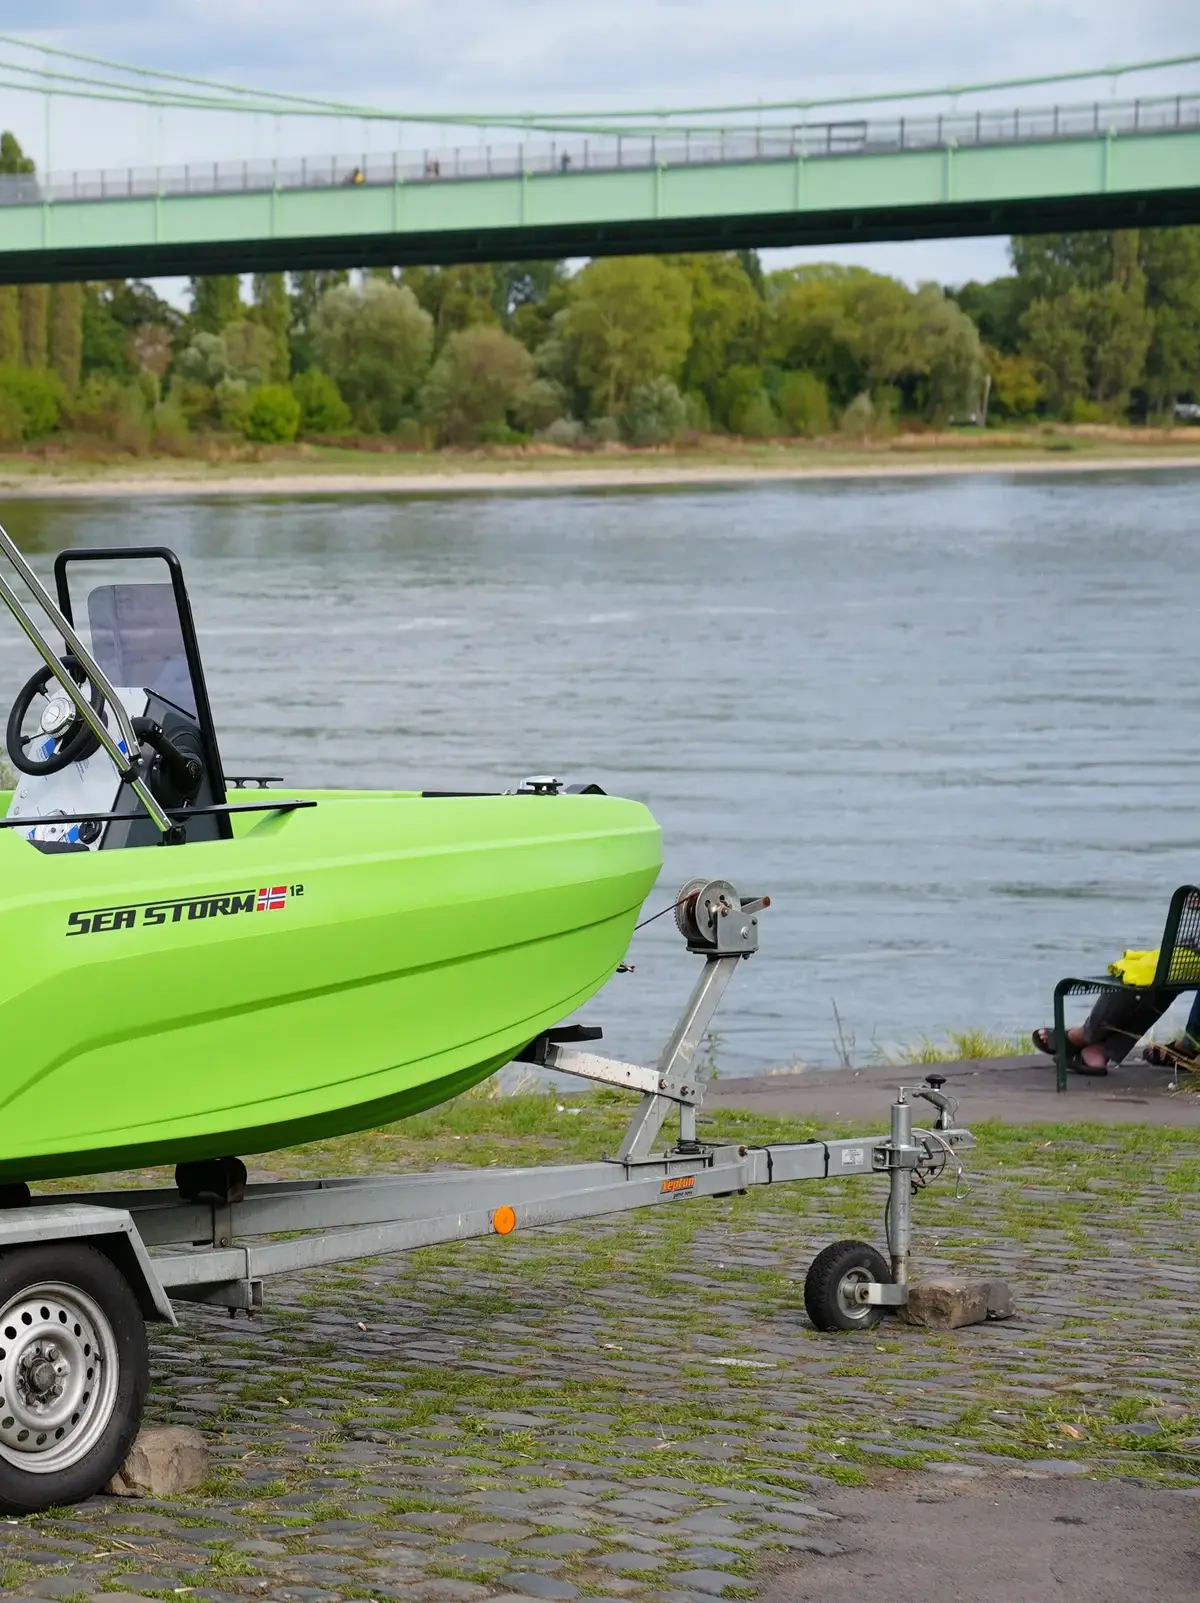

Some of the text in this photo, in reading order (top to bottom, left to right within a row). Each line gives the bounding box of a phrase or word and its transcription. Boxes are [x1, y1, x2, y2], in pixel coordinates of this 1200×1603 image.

[66, 884, 304, 937] SEA STORM 12
